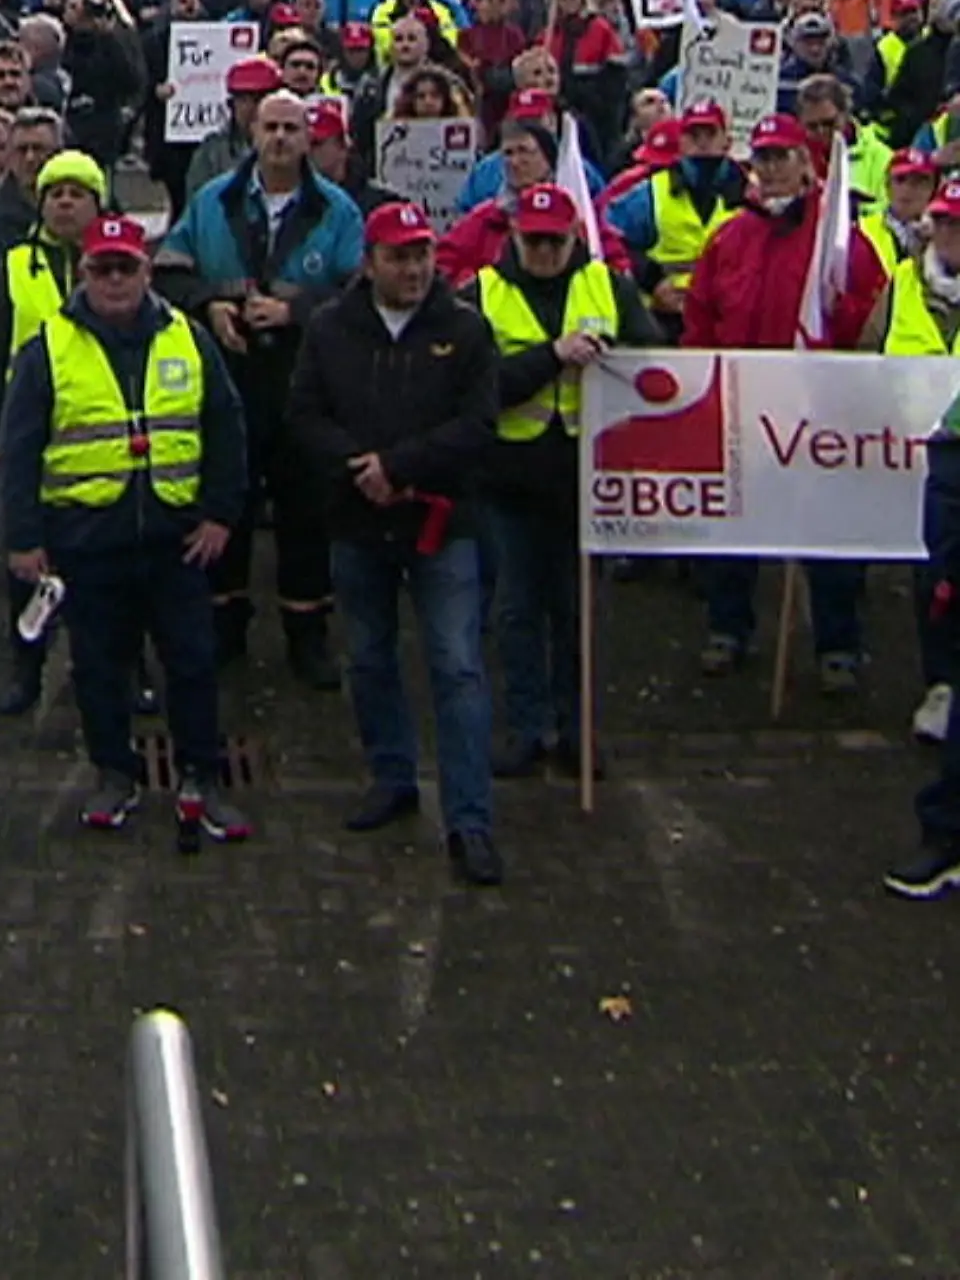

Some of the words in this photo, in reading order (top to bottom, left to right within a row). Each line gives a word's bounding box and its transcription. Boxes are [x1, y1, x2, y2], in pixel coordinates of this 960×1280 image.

[759, 414, 928, 469] Vertr
[592, 477, 624, 516] IG
[631, 476, 727, 517] BCE
